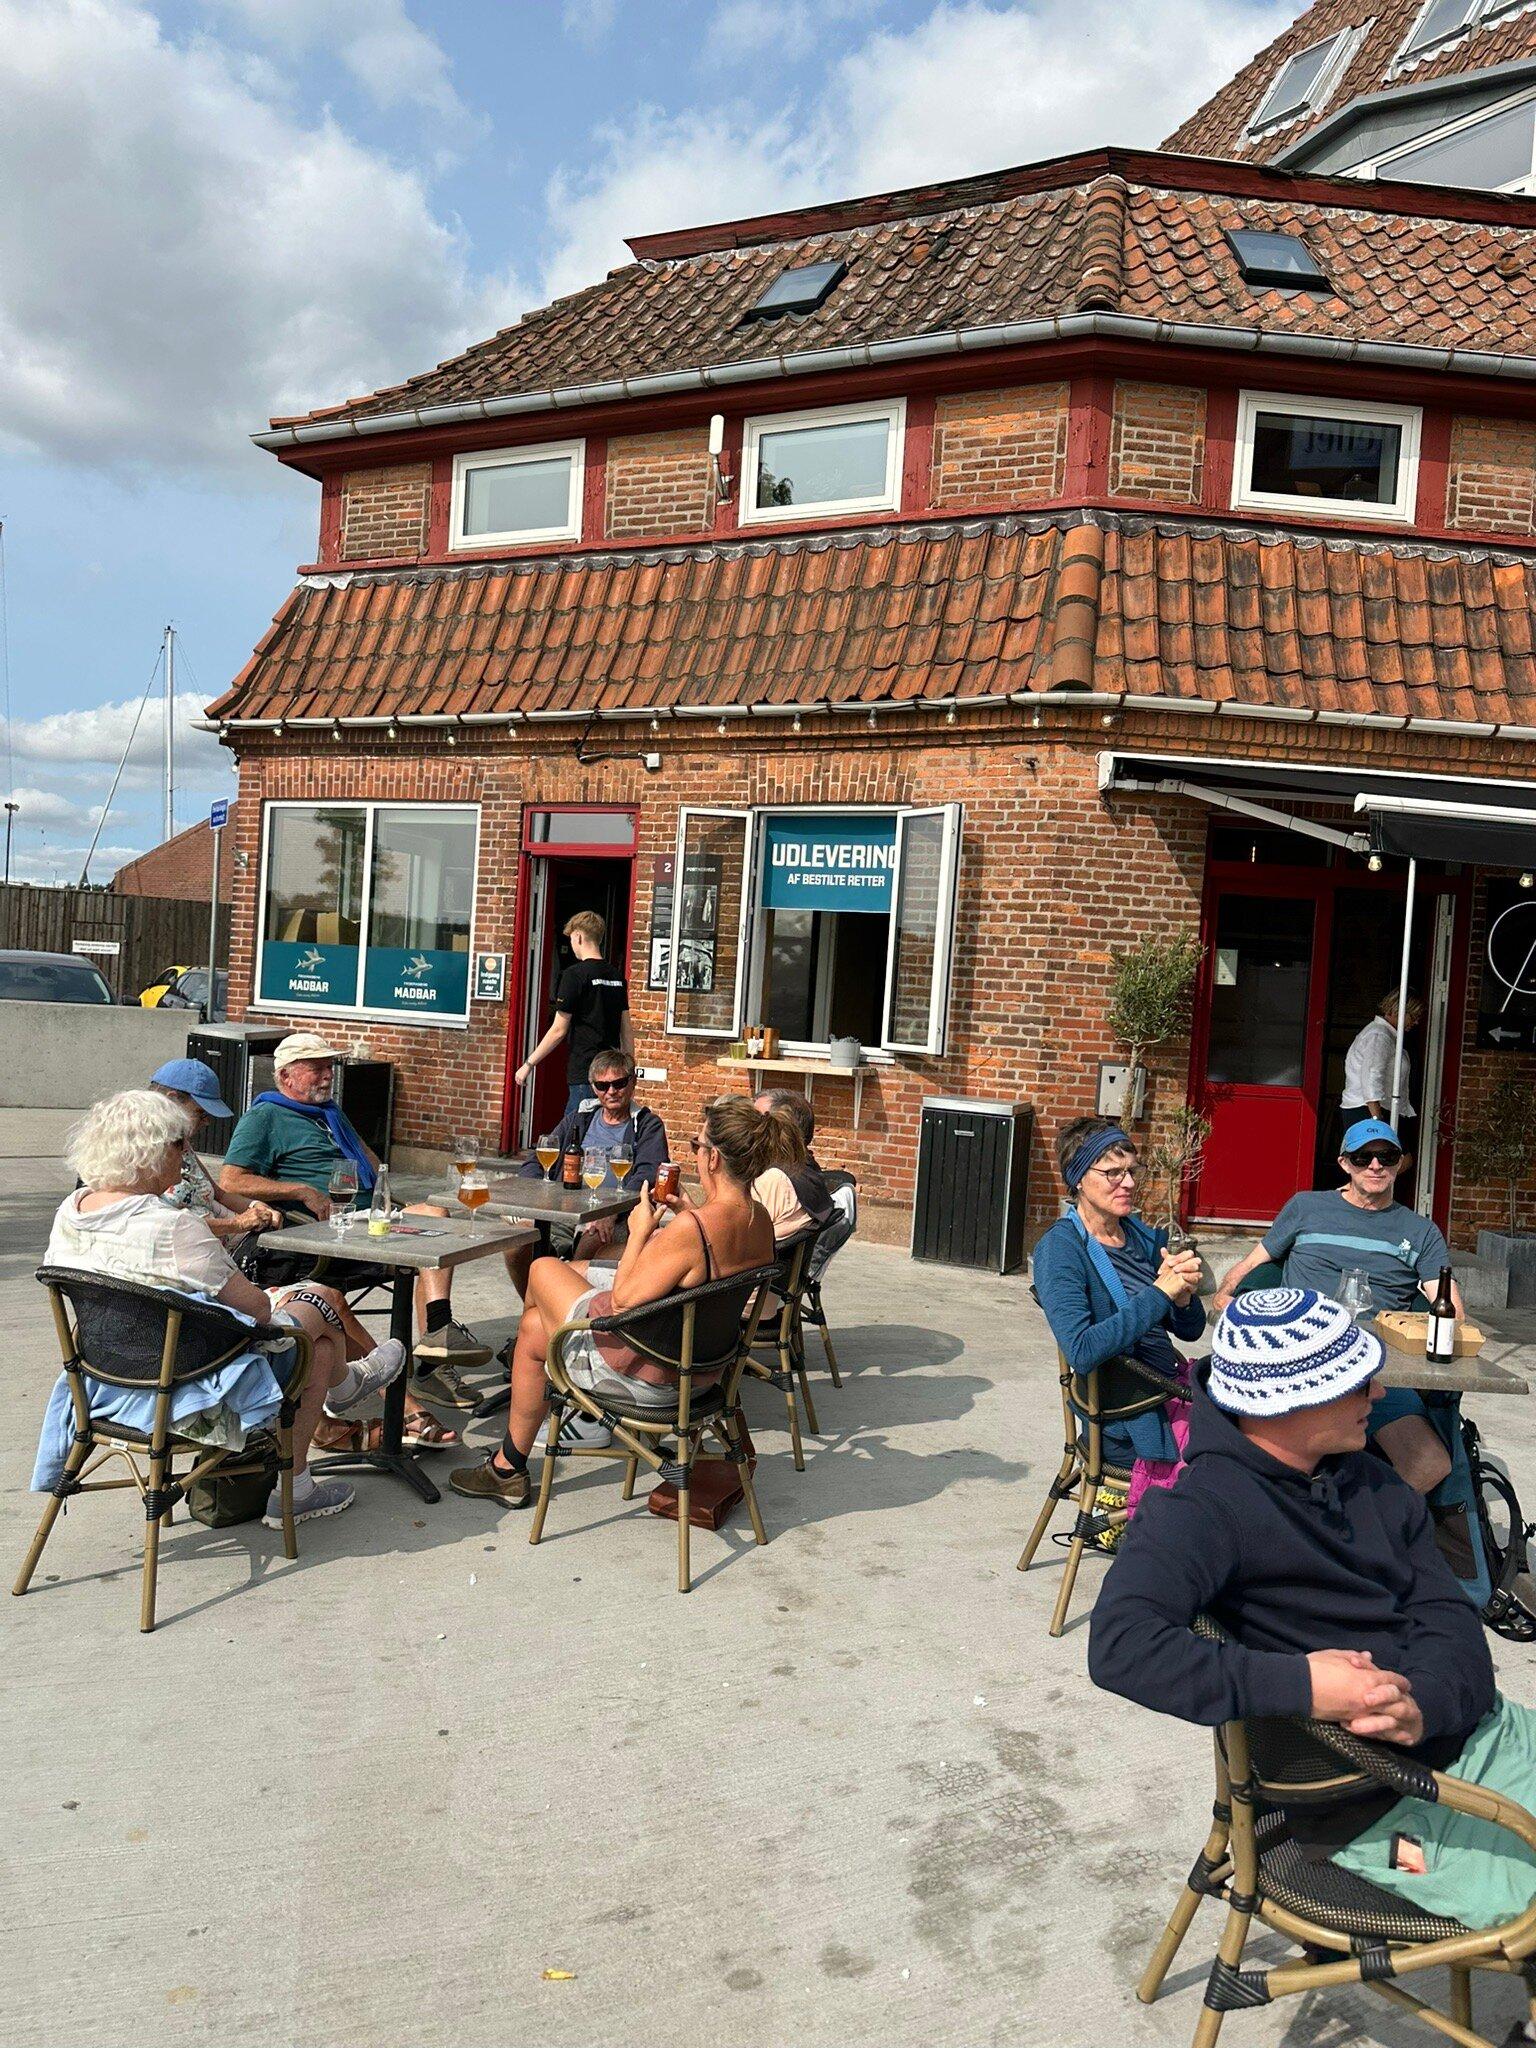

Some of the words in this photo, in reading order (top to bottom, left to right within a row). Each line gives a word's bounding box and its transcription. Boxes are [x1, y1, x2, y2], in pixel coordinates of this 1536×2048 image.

[664, 862, 672, 873] 2
[787, 873, 801, 885] AF
[802, 874, 846, 886] BESTILTE
[847, 875, 886, 887] RETTER
[289, 979, 329, 992] MADBAR
[394, 987, 436, 1000] MADBAR
